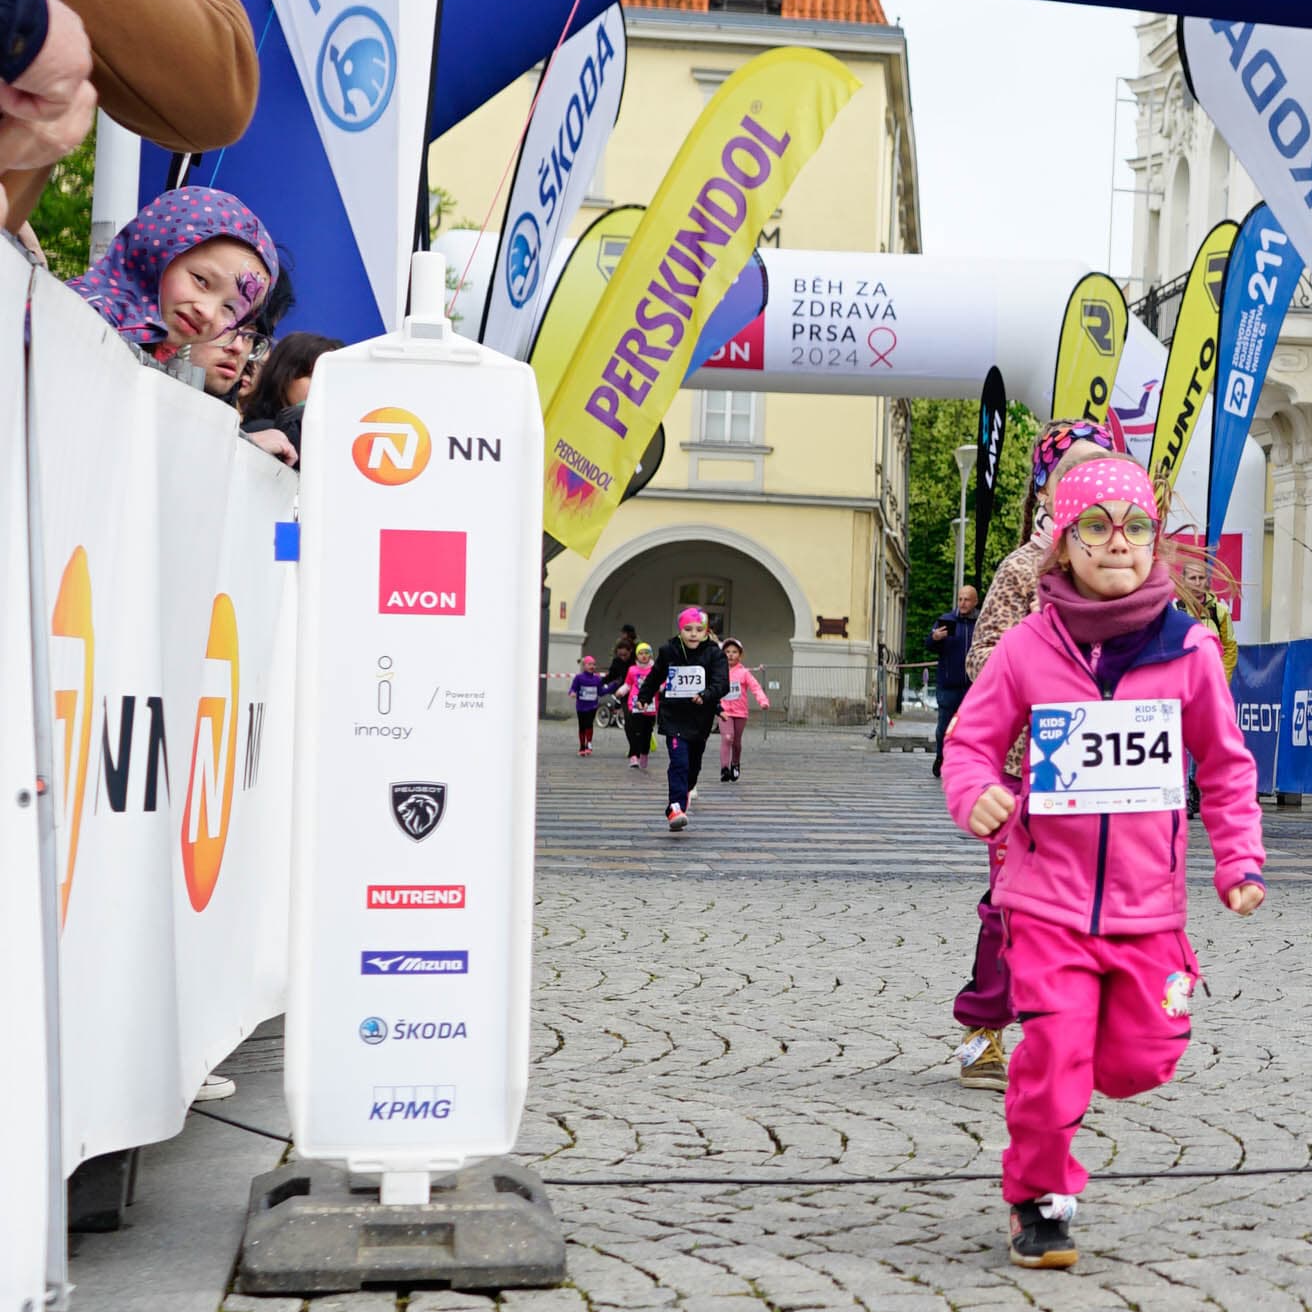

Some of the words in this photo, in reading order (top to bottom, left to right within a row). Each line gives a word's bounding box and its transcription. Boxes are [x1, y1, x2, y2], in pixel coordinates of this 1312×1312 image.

[538, 24, 614, 226] ŠKODA
[1248, 228, 1288, 305] 211
[585, 115, 791, 439] PERSKINDOL
[794, 278, 842, 295] BĚH
[857, 281, 887, 296] ZA
[792, 299, 897, 320] ZDRAVÁ
[792, 324, 856, 342] PRSA
[792, 347, 859, 367] 2024
[448, 436, 501, 462] NN
[554, 439, 613, 492] PERSKINDOL
[387, 591, 456, 608] AVON
[678, 674, 702, 686] 3173
[445, 691, 485, 699] Powered
[445, 701, 455, 709] by
[1039, 718, 1065, 727] KIDS
[1237, 702, 1282, 733] GEOT
[354, 722, 413, 739] innogy
[1040, 729, 1063, 740] CUP
[1082, 731, 1172, 767] 3154
[371, 890, 462, 904] NUTREND
[393, 1019, 467, 1039] ŠKODA
[369, 1100, 451, 1120] KPMG
